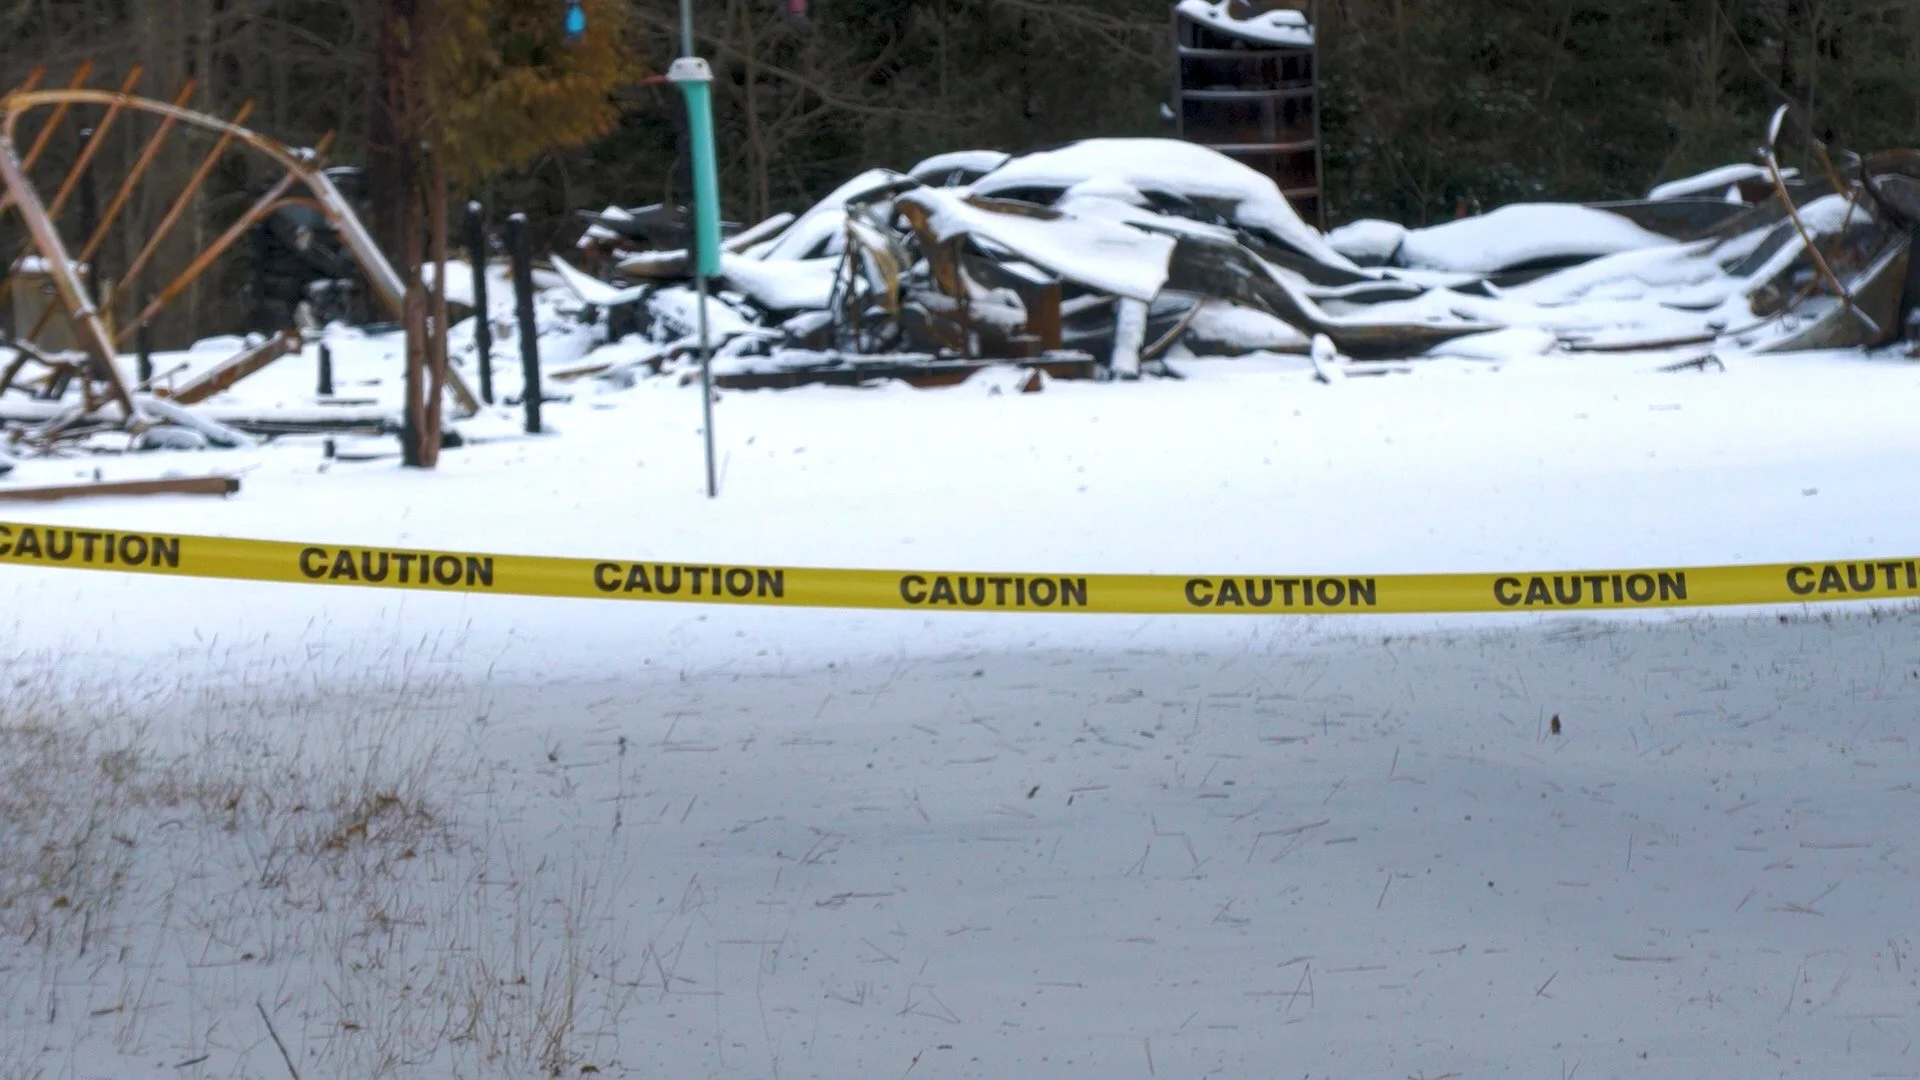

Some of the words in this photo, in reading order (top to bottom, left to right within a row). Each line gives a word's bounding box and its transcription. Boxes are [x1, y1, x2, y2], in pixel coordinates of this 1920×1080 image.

[300, 547, 494, 587] CAUTION
[594, 563, 785, 598] CAUTION
[900, 575, 1088, 607] CAUTION
[1185, 578, 1377, 607] CAUTION
[1493, 572, 1688, 607] CAUTION
[1786, 561, 1920, 596] CAUTI
